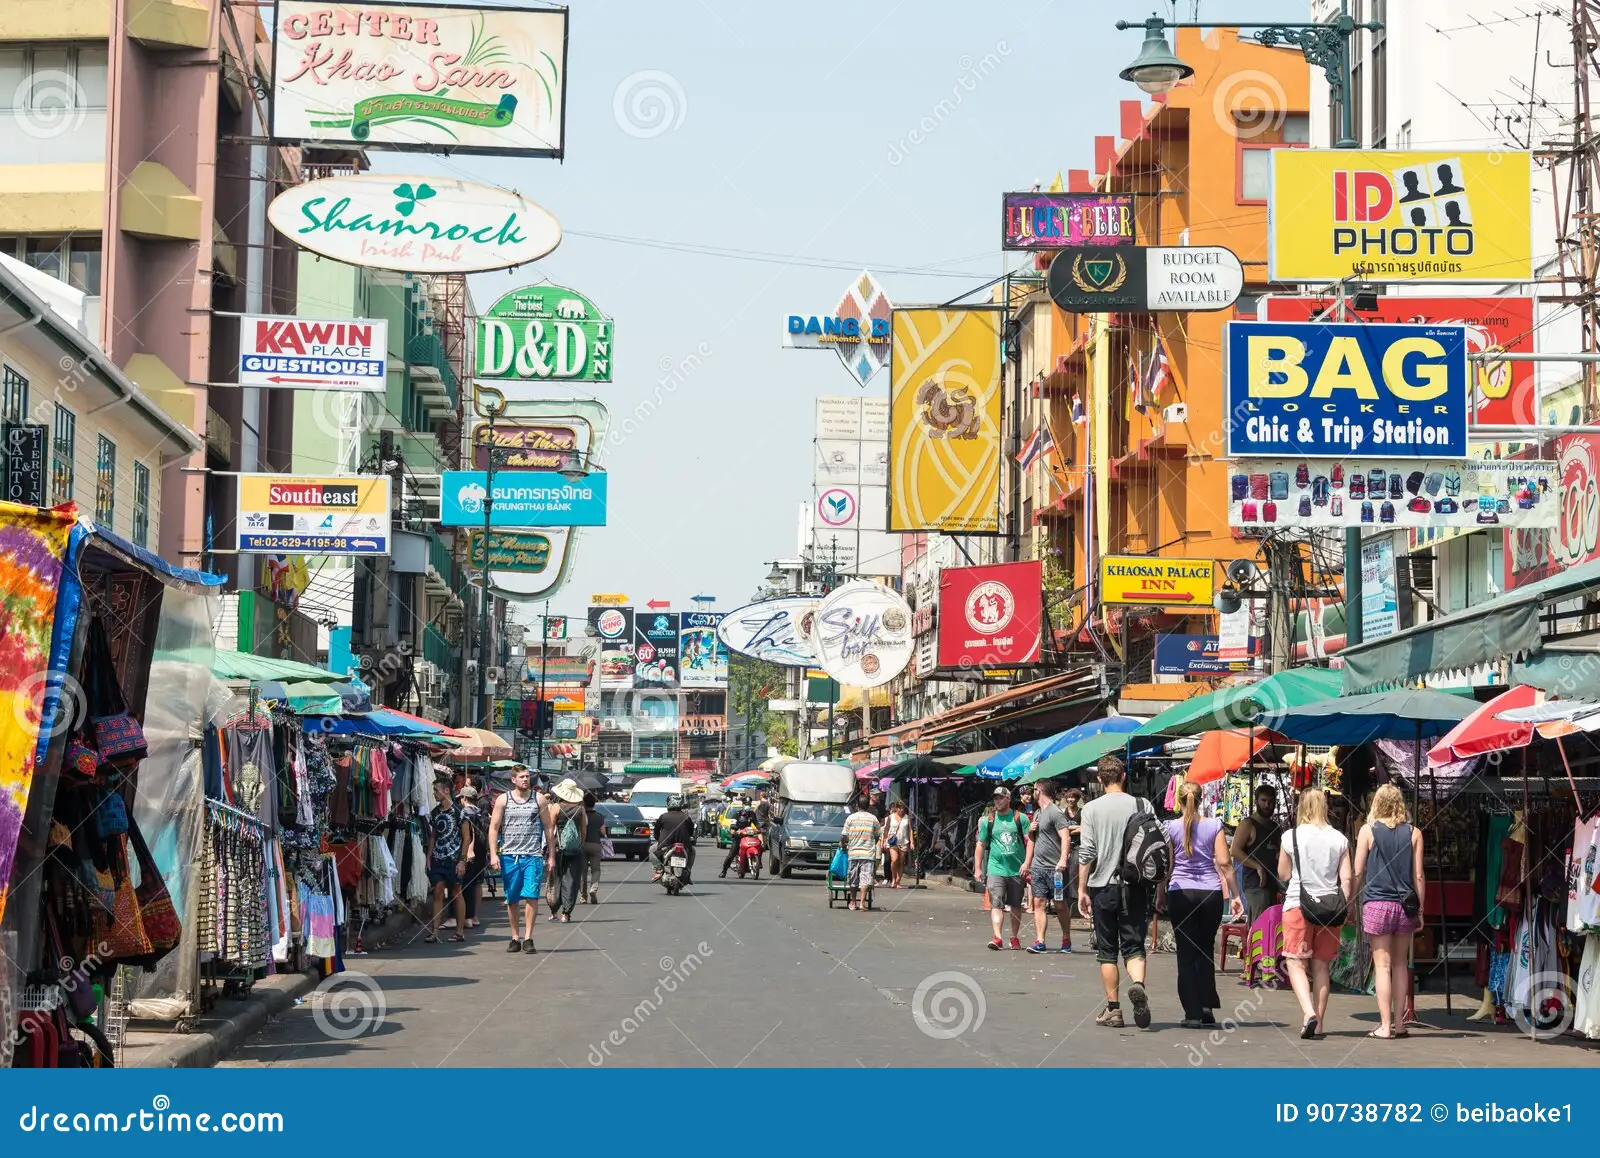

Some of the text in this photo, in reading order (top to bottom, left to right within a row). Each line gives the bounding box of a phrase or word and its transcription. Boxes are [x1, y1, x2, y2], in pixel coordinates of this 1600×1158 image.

[283, 10, 440, 46] CENTER
[282, 42, 517, 91] Khao Sarn
[1333, 169, 1395, 223] ID
[298, 197, 527, 245] Shamrock
[1006, 205, 1132, 238] LUCKY BEER
[361, 240, 463, 264] Irish Pub
[1333, 228, 1474, 256] PHOTO
[1163, 253, 1222, 265] BUDGET
[1170, 272, 1216, 285] ROOM
[1157, 290, 1232, 304] AVAILABLE
[788, 315, 859, 336] DANG
[256, 321, 372, 355] KAWIN
[312, 345, 371, 358] PLACE
[480, 320, 587, 379] D&D
[593, 323, 609, 375] INN
[245, 357, 380, 376] GUESTHOUSE
[1247, 335, 1448, 402] BAG
[1248, 402, 1448, 414] LOCKER
[1246, 415, 1449, 450] Chic & Trip Station
[22, 462, 31, 471] &
[270, 486, 358, 505] Southeast
[492, 486, 592, 502] ธนาคารกรุงไทย
[492, 503, 571, 511] KRUNGTHAI BANK
[1107, 566, 1210, 578] KHAOSAN PALACE
[1141, 580, 1177, 590] INN
[603, 620, 622, 630] KING
[821, 608, 882, 641] Silk
